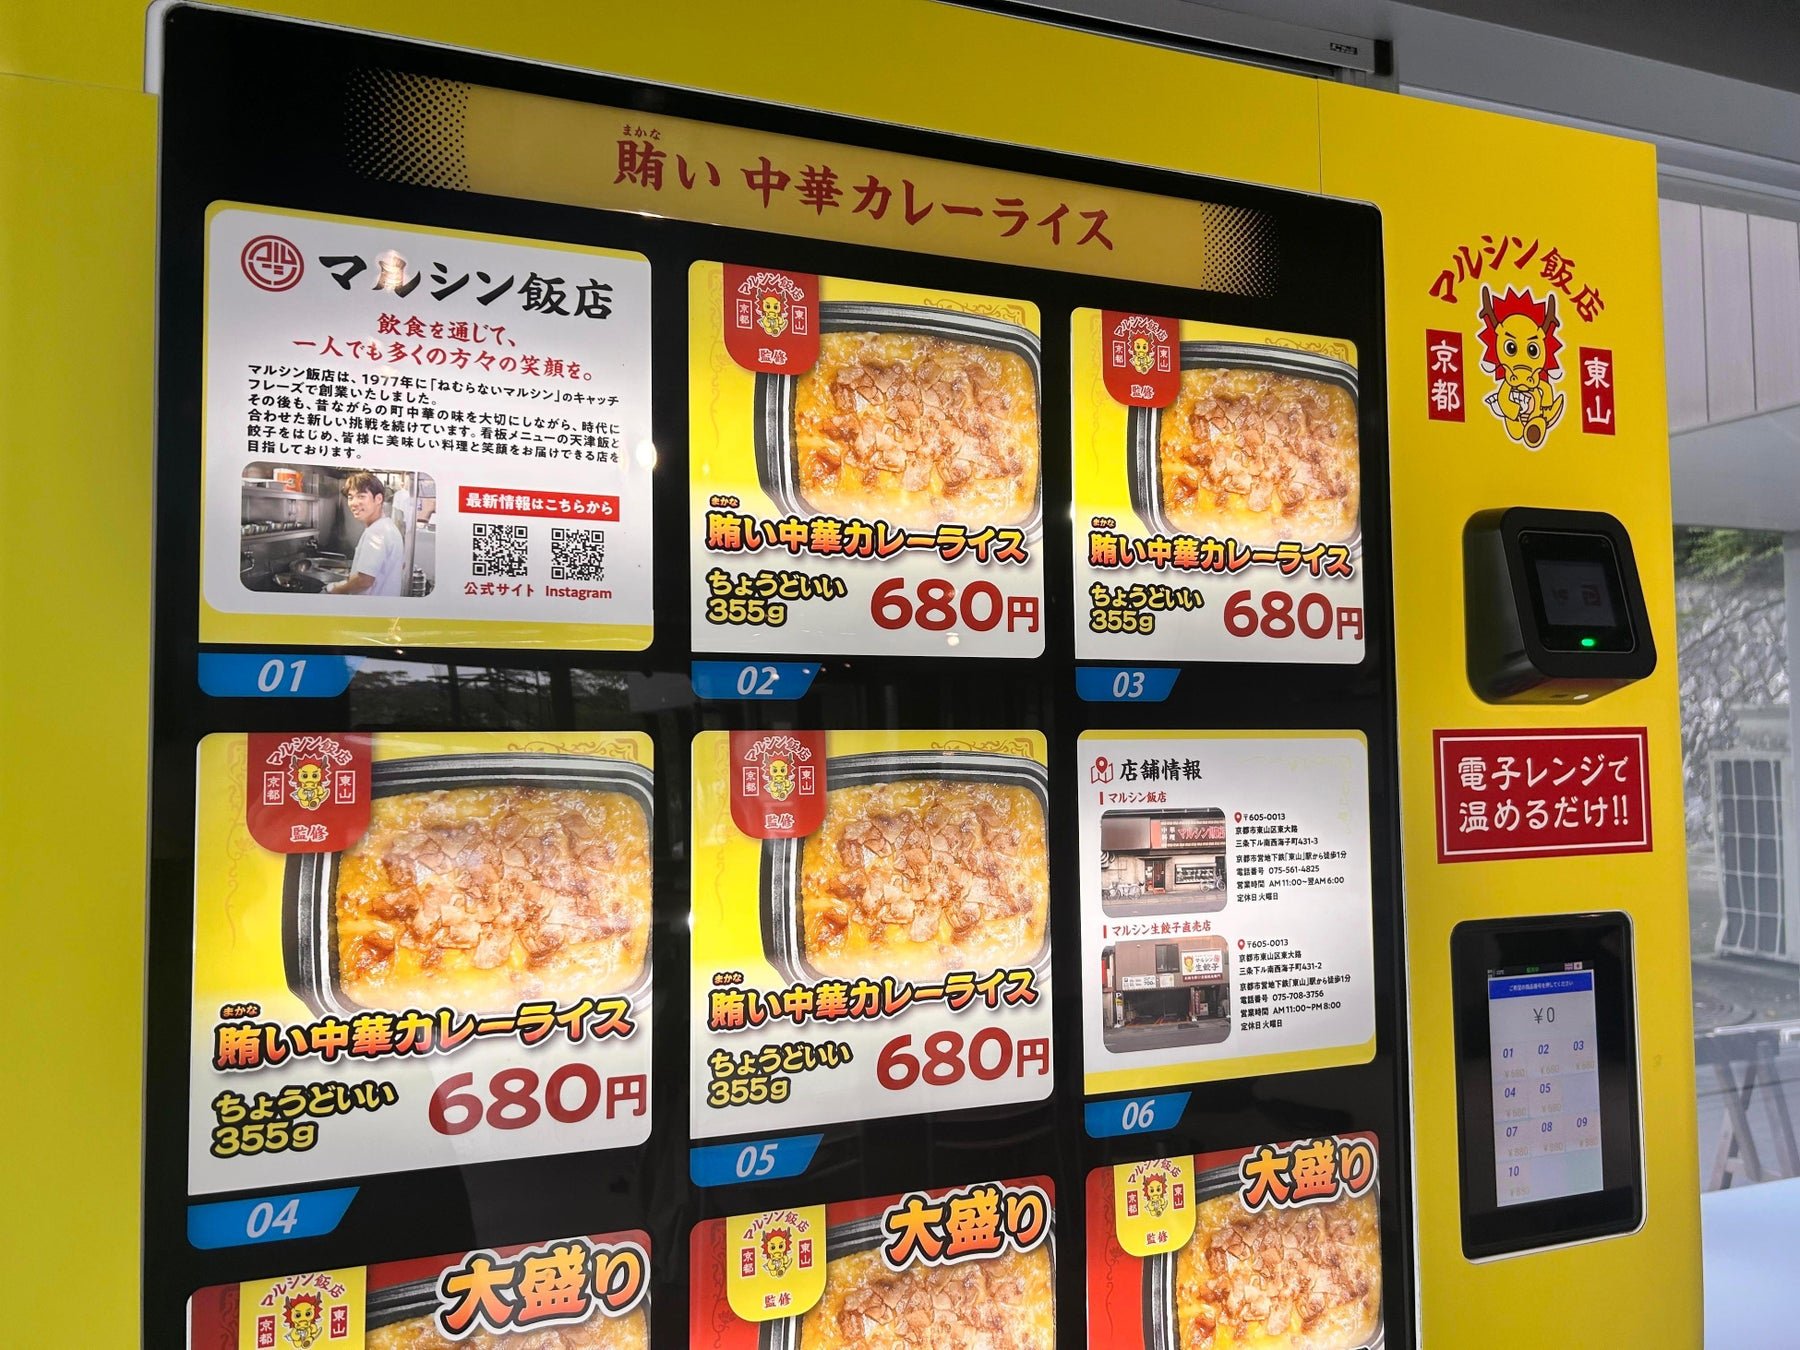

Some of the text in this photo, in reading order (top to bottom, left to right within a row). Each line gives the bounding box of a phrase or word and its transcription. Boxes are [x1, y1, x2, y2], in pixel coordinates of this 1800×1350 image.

[623, 125, 661, 141] まかな
[319, 254, 614, 320] マルシン飯店
[738, 273, 805, 301] マルシン飯店
[1429, 235, 1605, 323] マルシン飯店
[377, 312, 517, 347] 飲食を通じて、
[292, 335, 592, 382] 一人でも多くの方々の笑顔を。
[248, 364, 619, 407] マルシン飯店は、1977年に「ねむらないマルシン」のキャッチ
[1430, 339, 1461, 413] 京都
[1583, 356, 1612, 425] 東山
[248, 378, 437, 406] フレーズで創業いたしました。
[247, 393, 620, 435] その後も、昔ながらの町中華の味を大切にしながら、時代に
[247, 408, 621, 449] 合わせた新しい挑戦を続けています。看板メニューの天津飯と
[247, 424, 620, 463] 餃子をはじめ、皆様に美味しい料理と笑顔をお届けできる店を
[247, 440, 362, 460] 目指しております。
[466, 493, 614, 516] 最新情報はこちらから
[710, 496, 739, 508] まかな
[706, 513, 1029, 562] 賄い中華カレーライス
[1091, 518, 1116, 529] まかな
[1089, 533, 1354, 578] 賄い中華カレーライス
[464, 582, 613, 601] 公式サイト Instagram
[707, 570, 847, 601] ちょうどいい
[1089, 584, 1205, 610] ちょうどいい
[707, 598, 787, 627] 355g
[870, 577, 1040, 633] 680円
[1223, 589, 1364, 641] 680円
[1089, 608, 1156, 635] 355g
[257, 659, 309, 693] 01
[736, 666, 777, 696] 02
[1112, 671, 1145, 699] 03
[266, 736, 353, 765] マルシン飯店
[744, 735, 812, 762] マルシン飯店
[1120, 758, 1203, 783] 店舗情報
[1457, 754, 1630, 792] 電子レンジで
[267, 776, 280, 801] 京都
[339, 774, 352, 799] 東山
[1107, 791, 1168, 805] マルシン飯店
[1235, 825, 1298, 835] 京都市東山区東大路
[1459, 795, 1630, 834] 温めるだけ!!
[1268, 865, 1320, 875] 075-561-4825
[1111, 920, 1212, 936] マルシン生餃子直売店
[1239, 950, 1302, 963] 京都市東山区東大路
[713, 972, 745, 985] まかな
[222, 1003, 261, 1018] まかな
[709, 969, 1038, 1030] 賄い中華カレーライス
[215, 999, 636, 1069] 賄い中華カレーライス
[1502, 1040, 1585, 1059] 01 02 03
[708, 1040, 855, 1079] ちょうどいい
[876, 1027, 1050, 1091] 680円
[213, 1080, 400, 1124] ちょうどいい
[428, 1062, 648, 1136] 680円
[707, 1075, 791, 1108] 355g
[1504, 1082, 1551, 1099] 04 05
[1121, 1099, 1156, 1130] 06
[1506, 1117, 1588, 1138] 07 08 09
[211, 1121, 319, 1158] 355g
[735, 1143, 778, 1179] 05
[1242, 1138, 1375, 1209] 大盛り
[1508, 1165, 1520, 1177] 10
[245, 1199, 300, 1239] 04
[743, 1211, 810, 1239] マルシン飯店
[886, 1184, 1048, 1266] 大盛り
[1146, 1230, 1168, 1245] 監修
[260, 1273, 346, 1306] マルシン飯店
[440, 1243, 645, 1333] 大盛り
[764, 1292, 792, 1309] 監修
